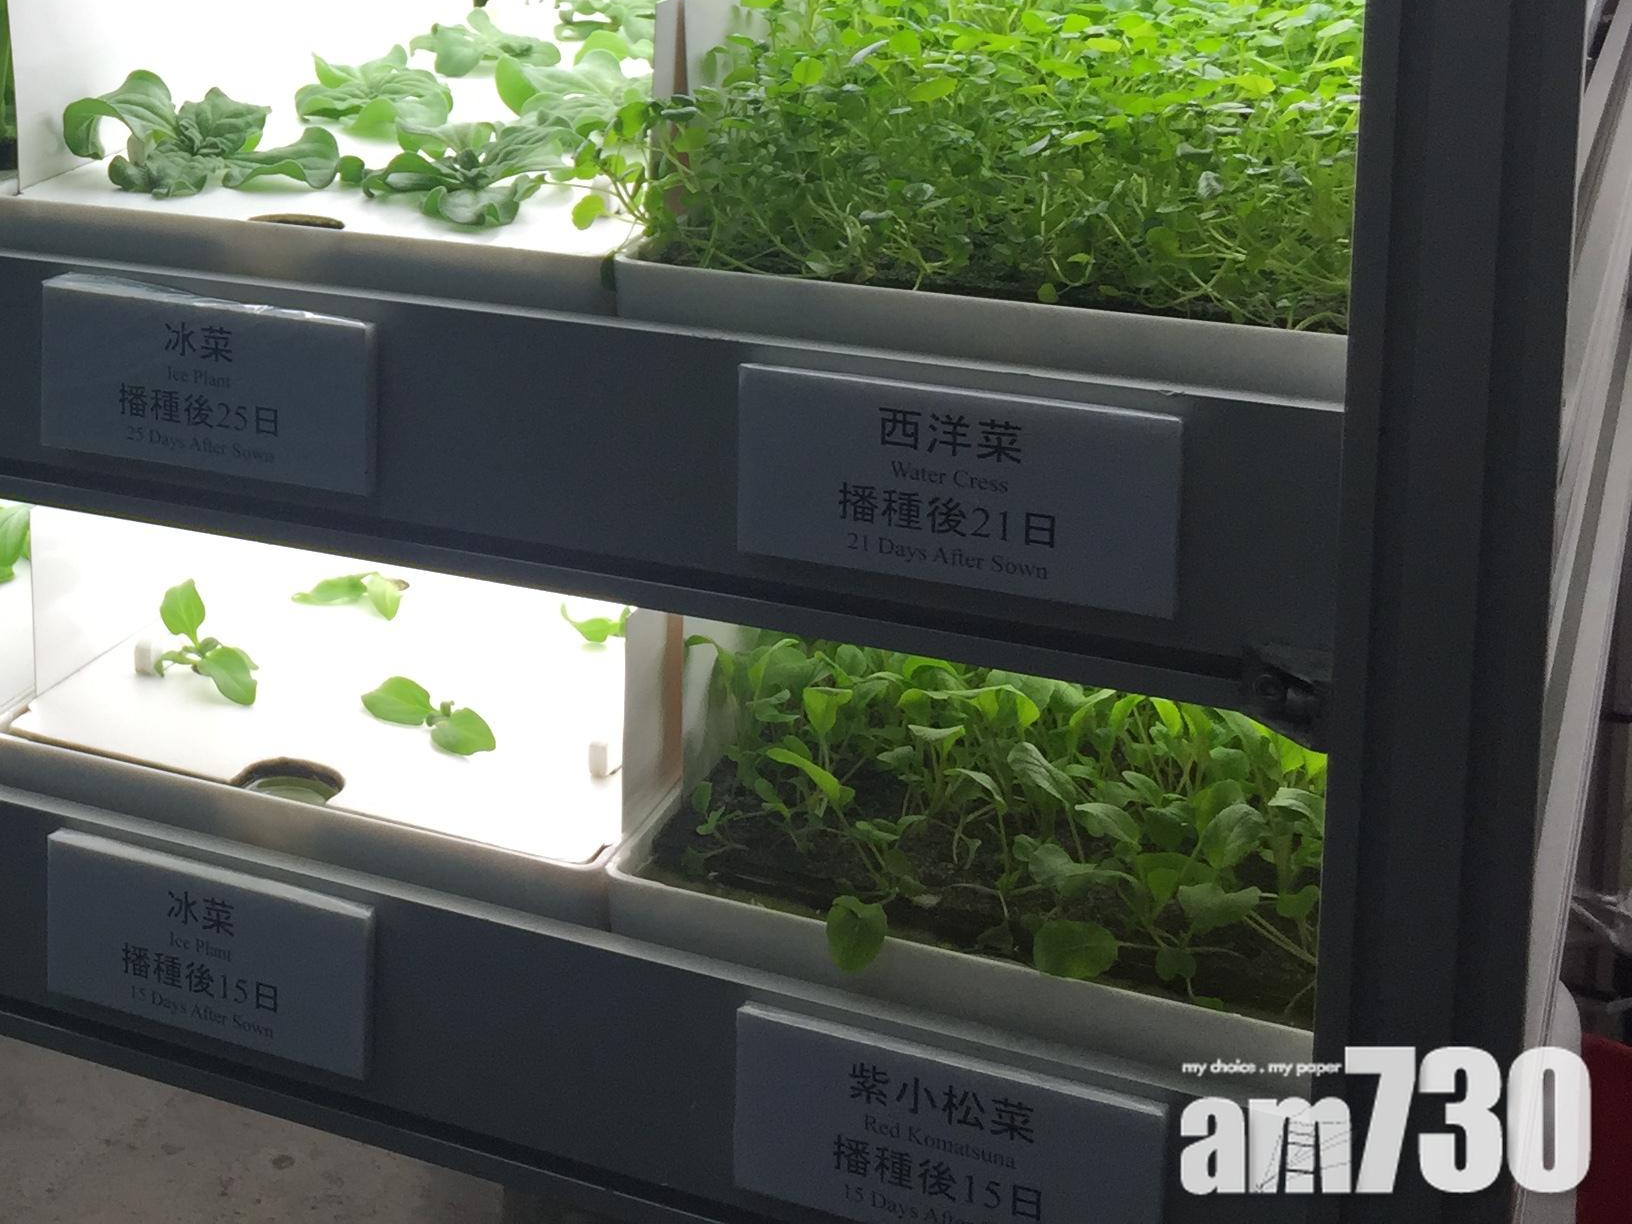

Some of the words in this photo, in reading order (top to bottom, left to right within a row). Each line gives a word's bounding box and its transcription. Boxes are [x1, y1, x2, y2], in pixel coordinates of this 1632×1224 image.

[163, 321, 234, 364] 冰菜
[166, 365, 190, 383] Ice
[193, 367, 232, 390] Plant
[118, 382, 280, 438] 播種後25日
[878, 406, 1023, 465] 西洋菜
[125, 425, 145, 443] 25
[148, 428, 186, 451] Days
[189, 433, 227, 457] After
[231, 440, 276, 465] Sown
[891, 459, 947, 487] Water
[952, 468, 1010, 495] Cress
[837, 481, 1057, 550] 播種後21日
[846, 531, 871, 554] 21
[877, 534, 929, 564] Days
[932, 544, 986, 572] After
[991, 553, 1050, 581] Sown
[166, 889, 236, 939] 冰菜
[168, 930, 191, 952] Ice
[195, 936, 233, 964] Plant
[121, 941, 280, 1015] 播種後15日
[129, 984, 148, 1003] 15
[151, 991, 188, 1016] Days
[189, 1003, 230, 1028] After
[232, 1014, 276, 1040] Sown
[848, 1061, 1036, 1145] 紫小松菜
[862, 1113, 902, 1139] Red
[907, 1124, 1018, 1171] Komatsuna
[832, 1133, 1043, 1222] 播種後15日
[842, 1183, 866, 1204] 15
[869, 1189, 919, 1222] Days
